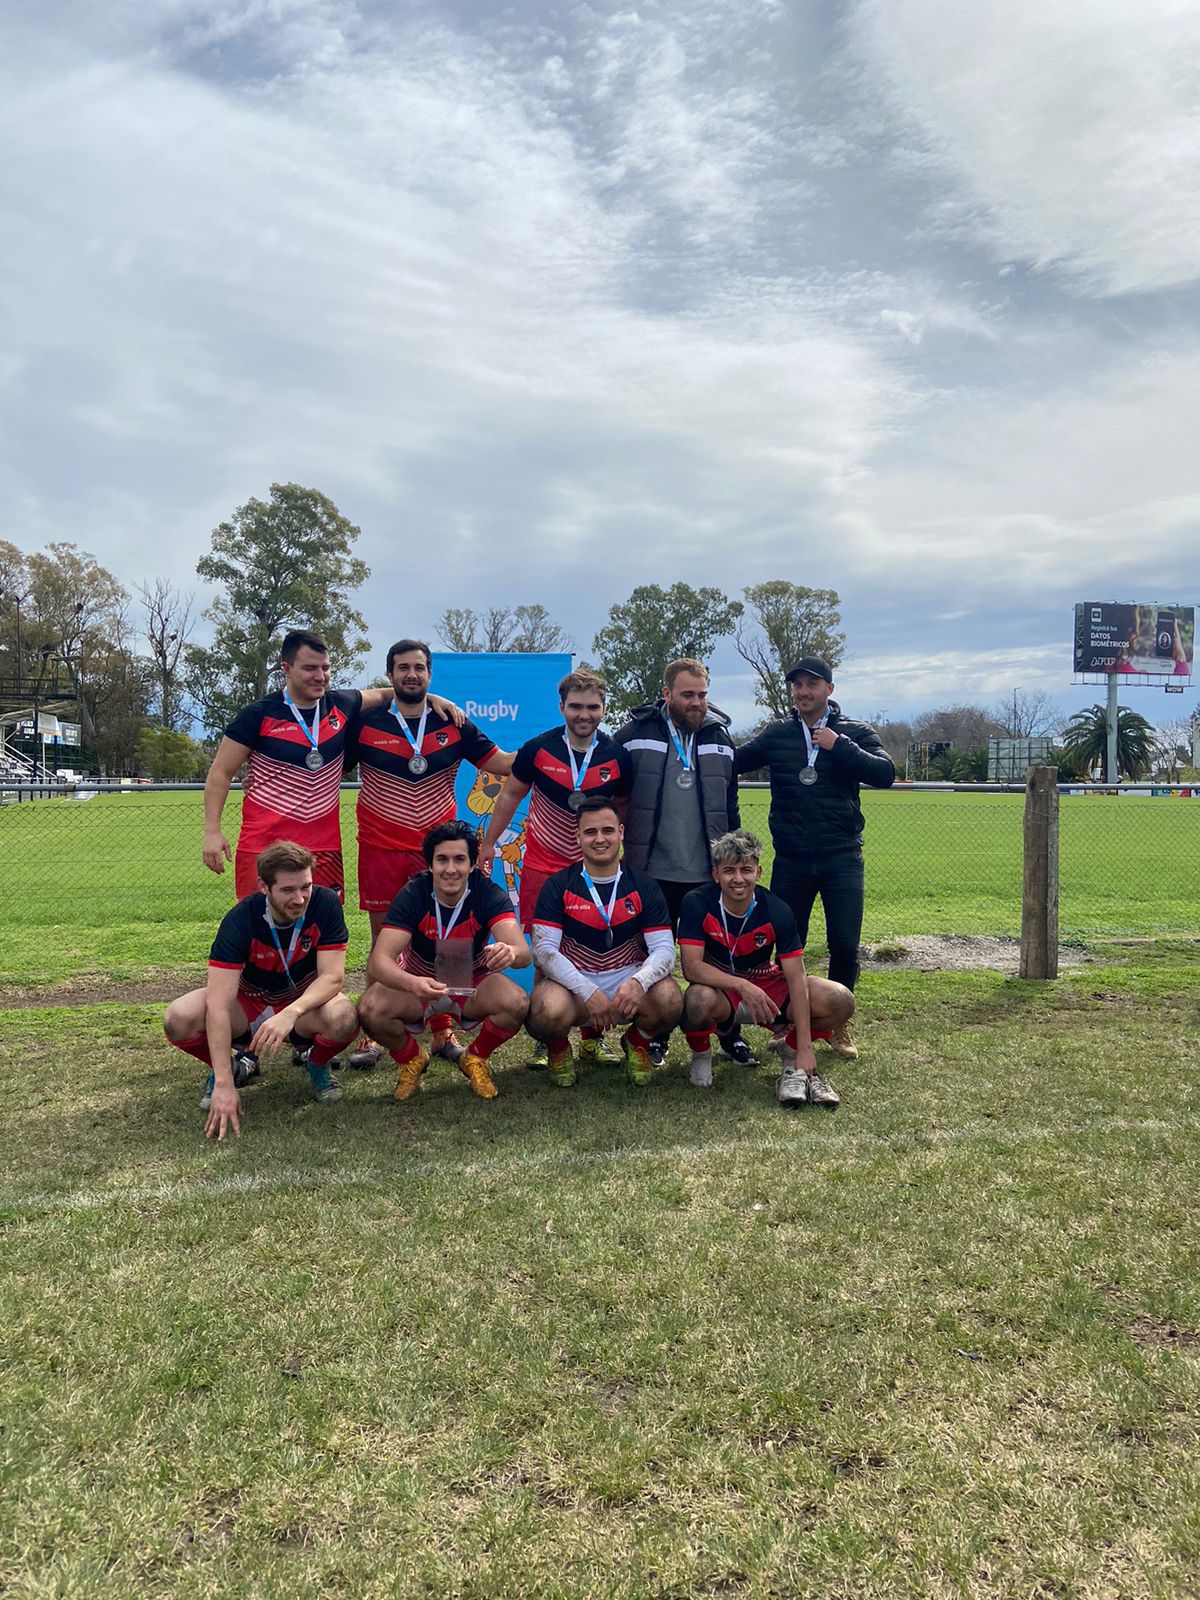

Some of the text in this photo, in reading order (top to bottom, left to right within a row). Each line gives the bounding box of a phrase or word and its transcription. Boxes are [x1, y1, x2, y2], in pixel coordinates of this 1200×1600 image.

[1090, 632, 1111, 640] DATOS
[1090, 639, 1130, 648] BIOMÉTRICOS
[465, 699, 519, 722] Rugby
